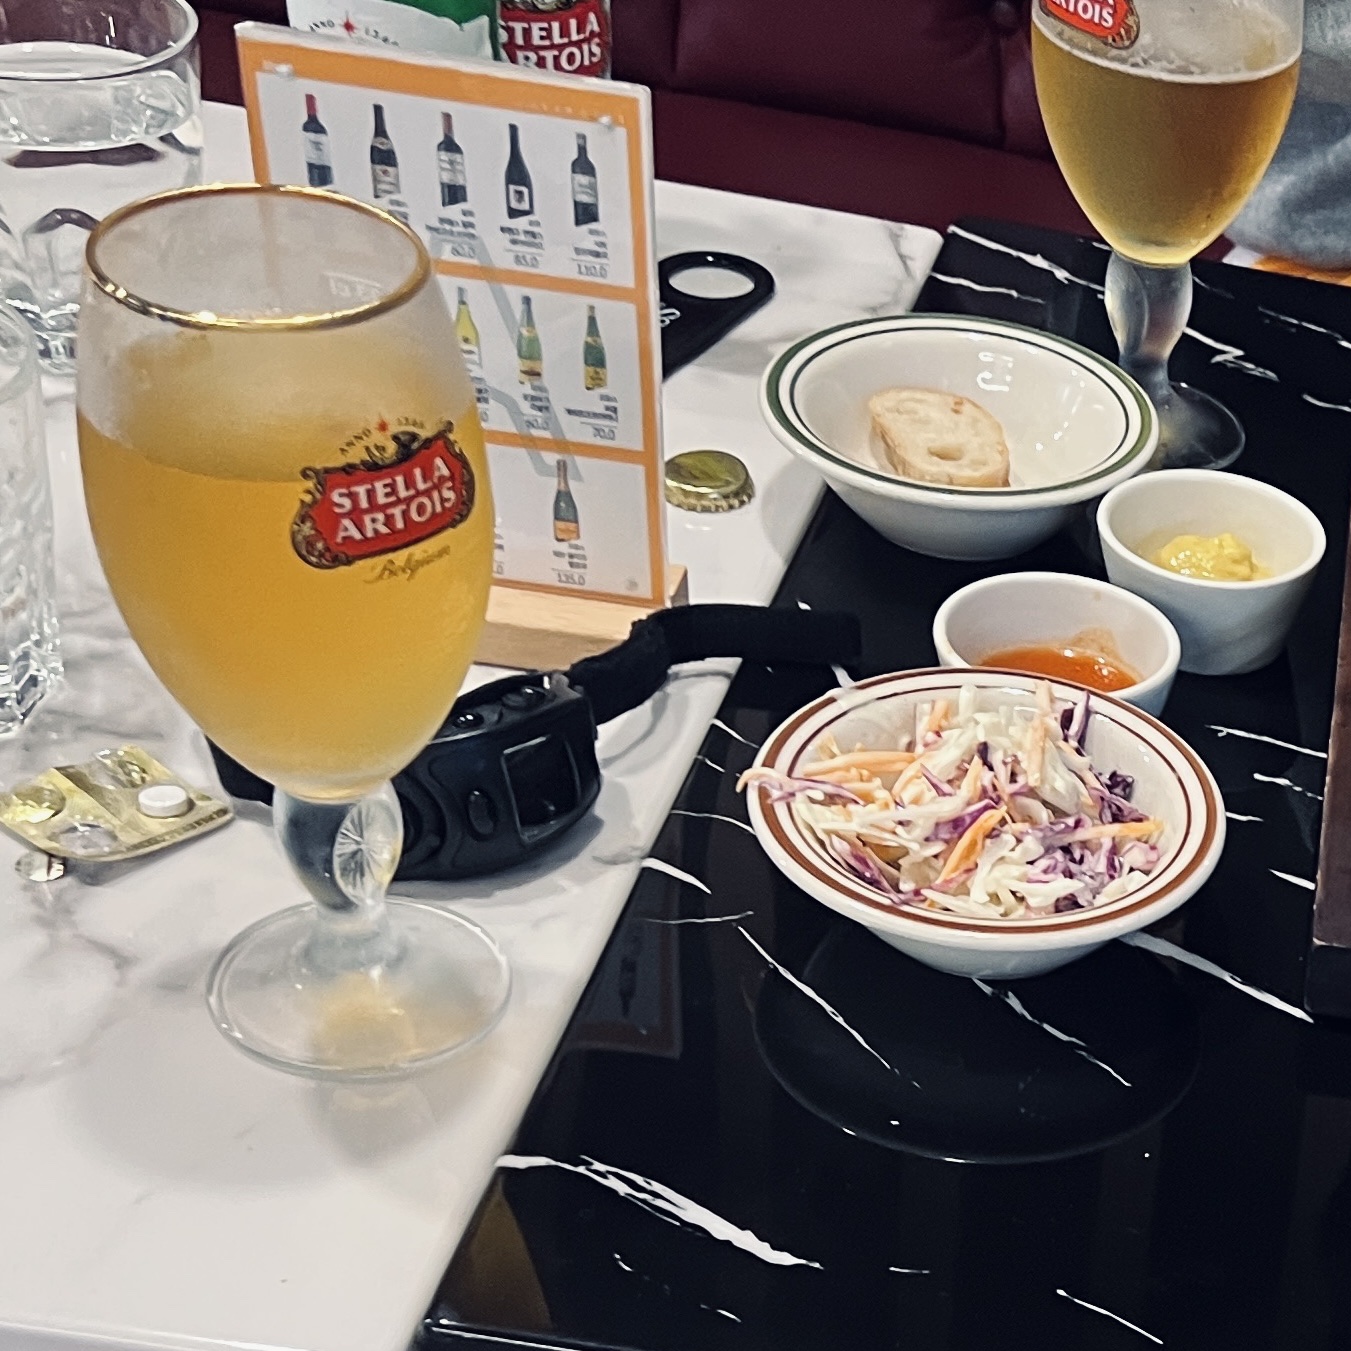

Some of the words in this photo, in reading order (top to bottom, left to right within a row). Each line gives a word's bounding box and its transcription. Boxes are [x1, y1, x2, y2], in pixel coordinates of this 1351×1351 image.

[1052, 0, 1113, 28] TOIS
[330, 456, 452, 514] STELLA
[335, 480, 457, 545] ARTOIS
